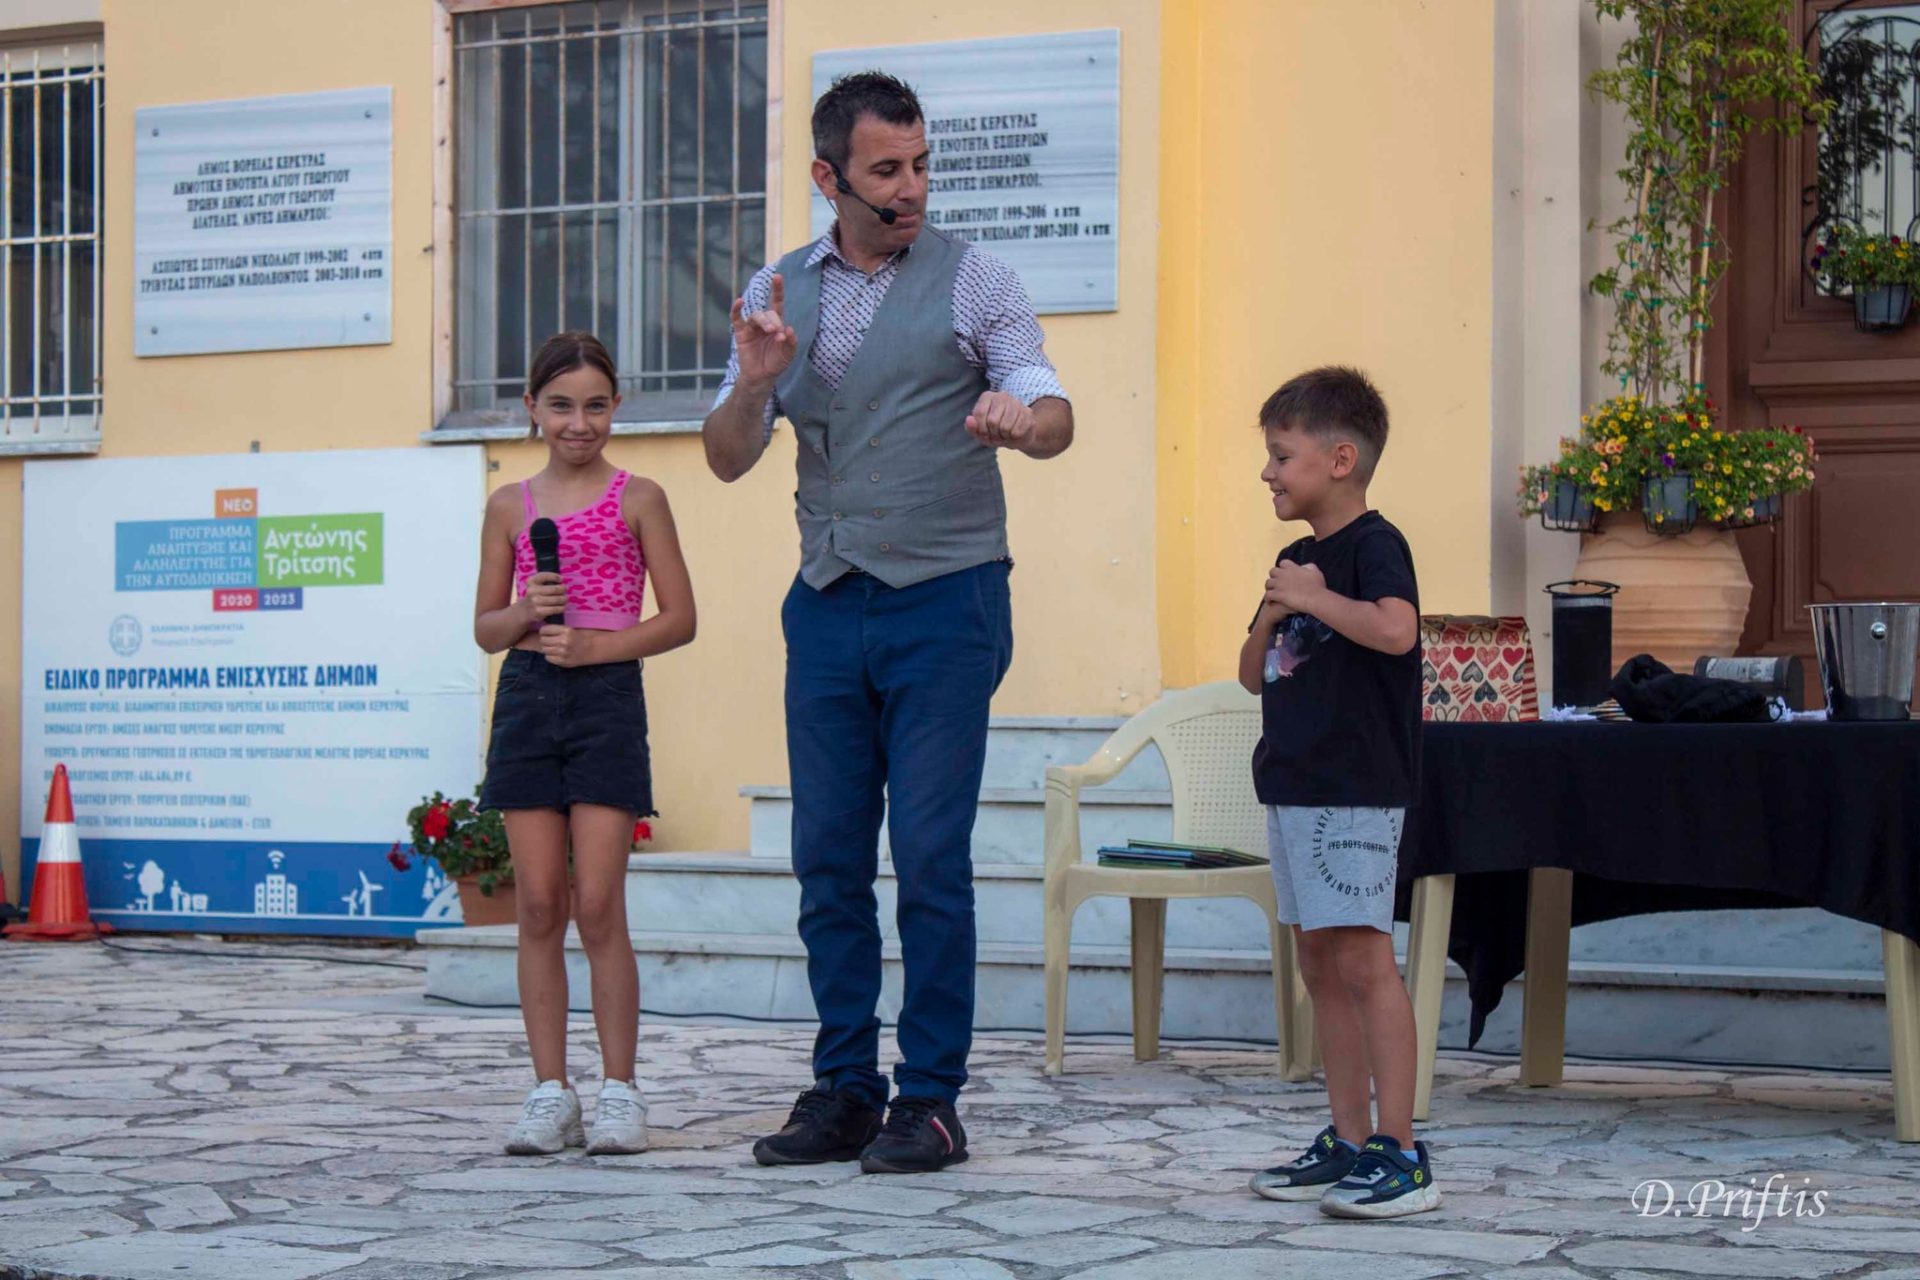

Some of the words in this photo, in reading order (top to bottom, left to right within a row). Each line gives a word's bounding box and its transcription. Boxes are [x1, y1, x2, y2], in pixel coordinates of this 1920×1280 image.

[930, 118, 976, 134] ΒΟΡΕΙΑΣ
[980, 113, 1037, 130] ΚΕΡΚΥΡΑΣ
[939, 137, 990, 153] ΕΝΟΤΗΤΑ
[993, 132, 1048, 149] ΕΣΠΕΡΙΩΝ
[198, 159, 230, 176] ΔΗΜΟΣ
[233, 157, 273, 173] ΒΟΡΕΙΑΣ
[276, 153, 326, 170] ΚΕΡΚΥΡΑΣ
[934, 157, 972, 172] ΔΗΜΟΣ
[976, 153, 1031, 171] ΕΣΠΕΡΙΩΝ
[173, 179, 222, 195] ΔΗΜΟΤΙΚΗ
[226, 175, 269, 192] ΕΝΟΤΗΤΑ
[271, 173, 301, 188] ΑΓΙΟΥ
[303, 169, 350, 185] ΓΕΩΡΓΙΟΥ
[221, 195, 254, 210] ΔΗΜΟΣ
[257, 192, 286, 207] ΑΓΙΟΥ
[288, 188, 336, 204] ΓΕΩΡΓΙΟΥ
[944, 207, 1000, 223] ΔΗΜΗΤΡΙΟΥ
[1002, 204, 1047, 221] 1999-2006
[982, 225, 1031, 241] ΝΙΚΟΛΑΟΥ
[1034, 223, 1078, 238] 2007-2010
[202, 255, 248, 271] ΣΠΥΡΙΔΩΝ
[252, 252, 301, 268] ΝΙΚΟΛΑΟΥ
[188, 273, 235, 290] ΣΠΥΡΙΔΩΝ
[223, 499, 253, 512] ΝΕΟ
[169, 526, 252, 540] ΠΡΟΓΡΑΜΜΑ
[264, 523, 368, 551] Αντώνης
[147, 542, 225, 556] ΑΝΑΠΤΥΞΗΣ
[228, 541, 251, 554] ΚΑΙ
[133, 556, 227, 572] ΑΛΛΗΛΕΓΓΥΗΣ
[230, 556, 252, 570] ΓΙΑ
[264, 551, 356, 579] Τρίτσης
[125, 574, 151, 587] ΤΗΝ
[155, 572, 251, 587] ΑΥΤΟΔΙΟΙΚΗΣΗ
[220, 594, 253, 607] 2020
[264, 593, 296, 605] 2023
[45, 668, 100, 690] ΕΙΔΙΚΟ
[106, 667, 210, 689] ΠΡΟΓΡΑΜΜΑ
[216, 666, 309, 688] ΕΝΙΣΧΥΣΗΣ
[315, 664, 378, 687] ΔΗΜΩΝ
[1313, 807, 1334, 859] ELEVATE
[1318, 861, 1360, 896] CONTROL
[1366, 1143, 1384, 1151] FILA
